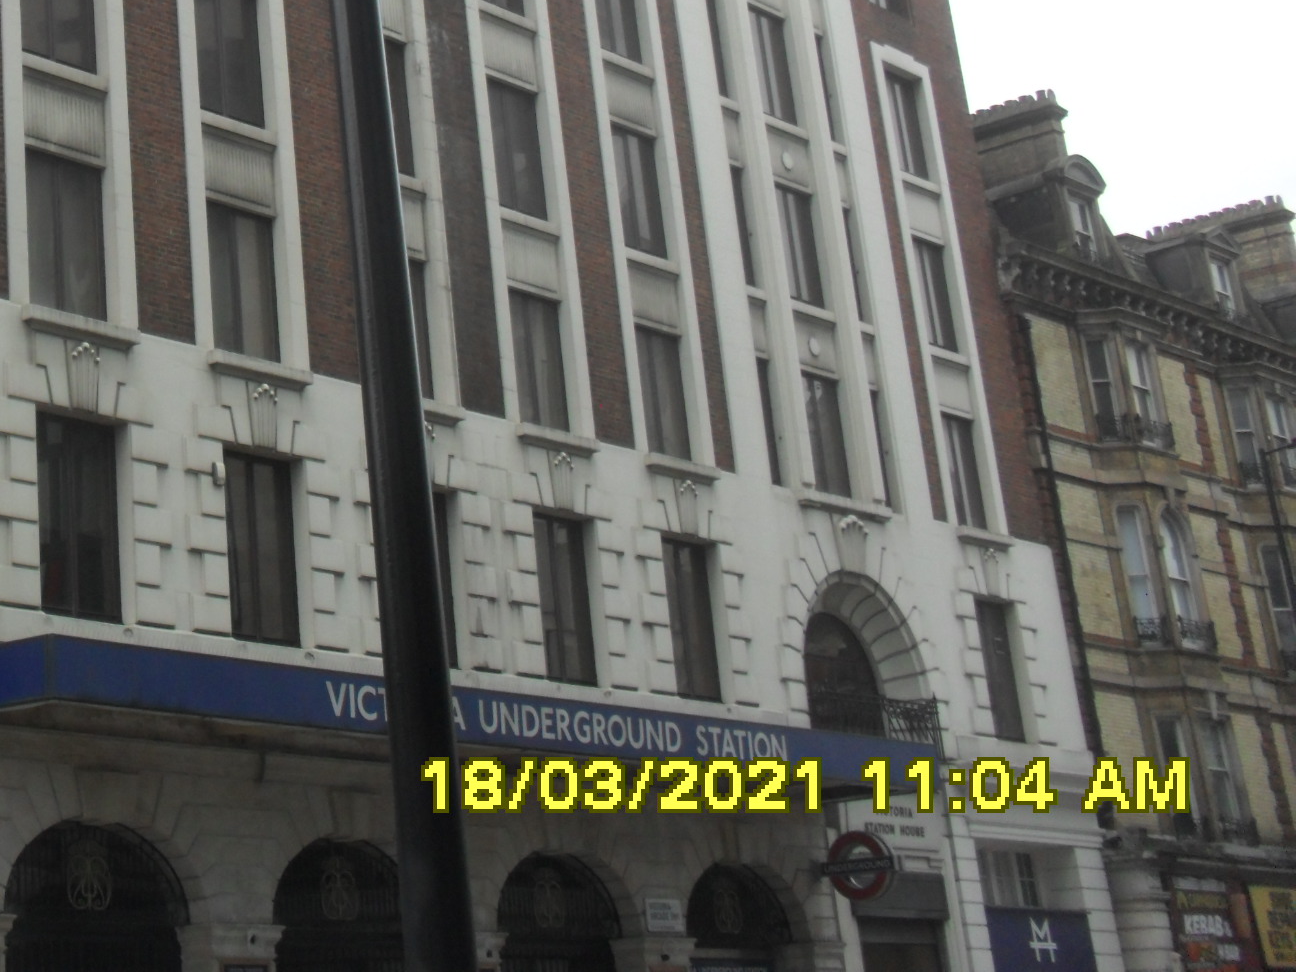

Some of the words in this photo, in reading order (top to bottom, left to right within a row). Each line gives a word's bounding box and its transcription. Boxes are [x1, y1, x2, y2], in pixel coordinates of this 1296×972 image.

[478, 700, 683, 753] UNDERGROUND
[695, 724, 789, 762] STATION
[864, 822, 896, 835] STATION
[900, 825, 926, 838] HOUSE
[823, 858, 891, 874] UNDERGROUND
[1183, 913, 1224, 937] KEBAB
